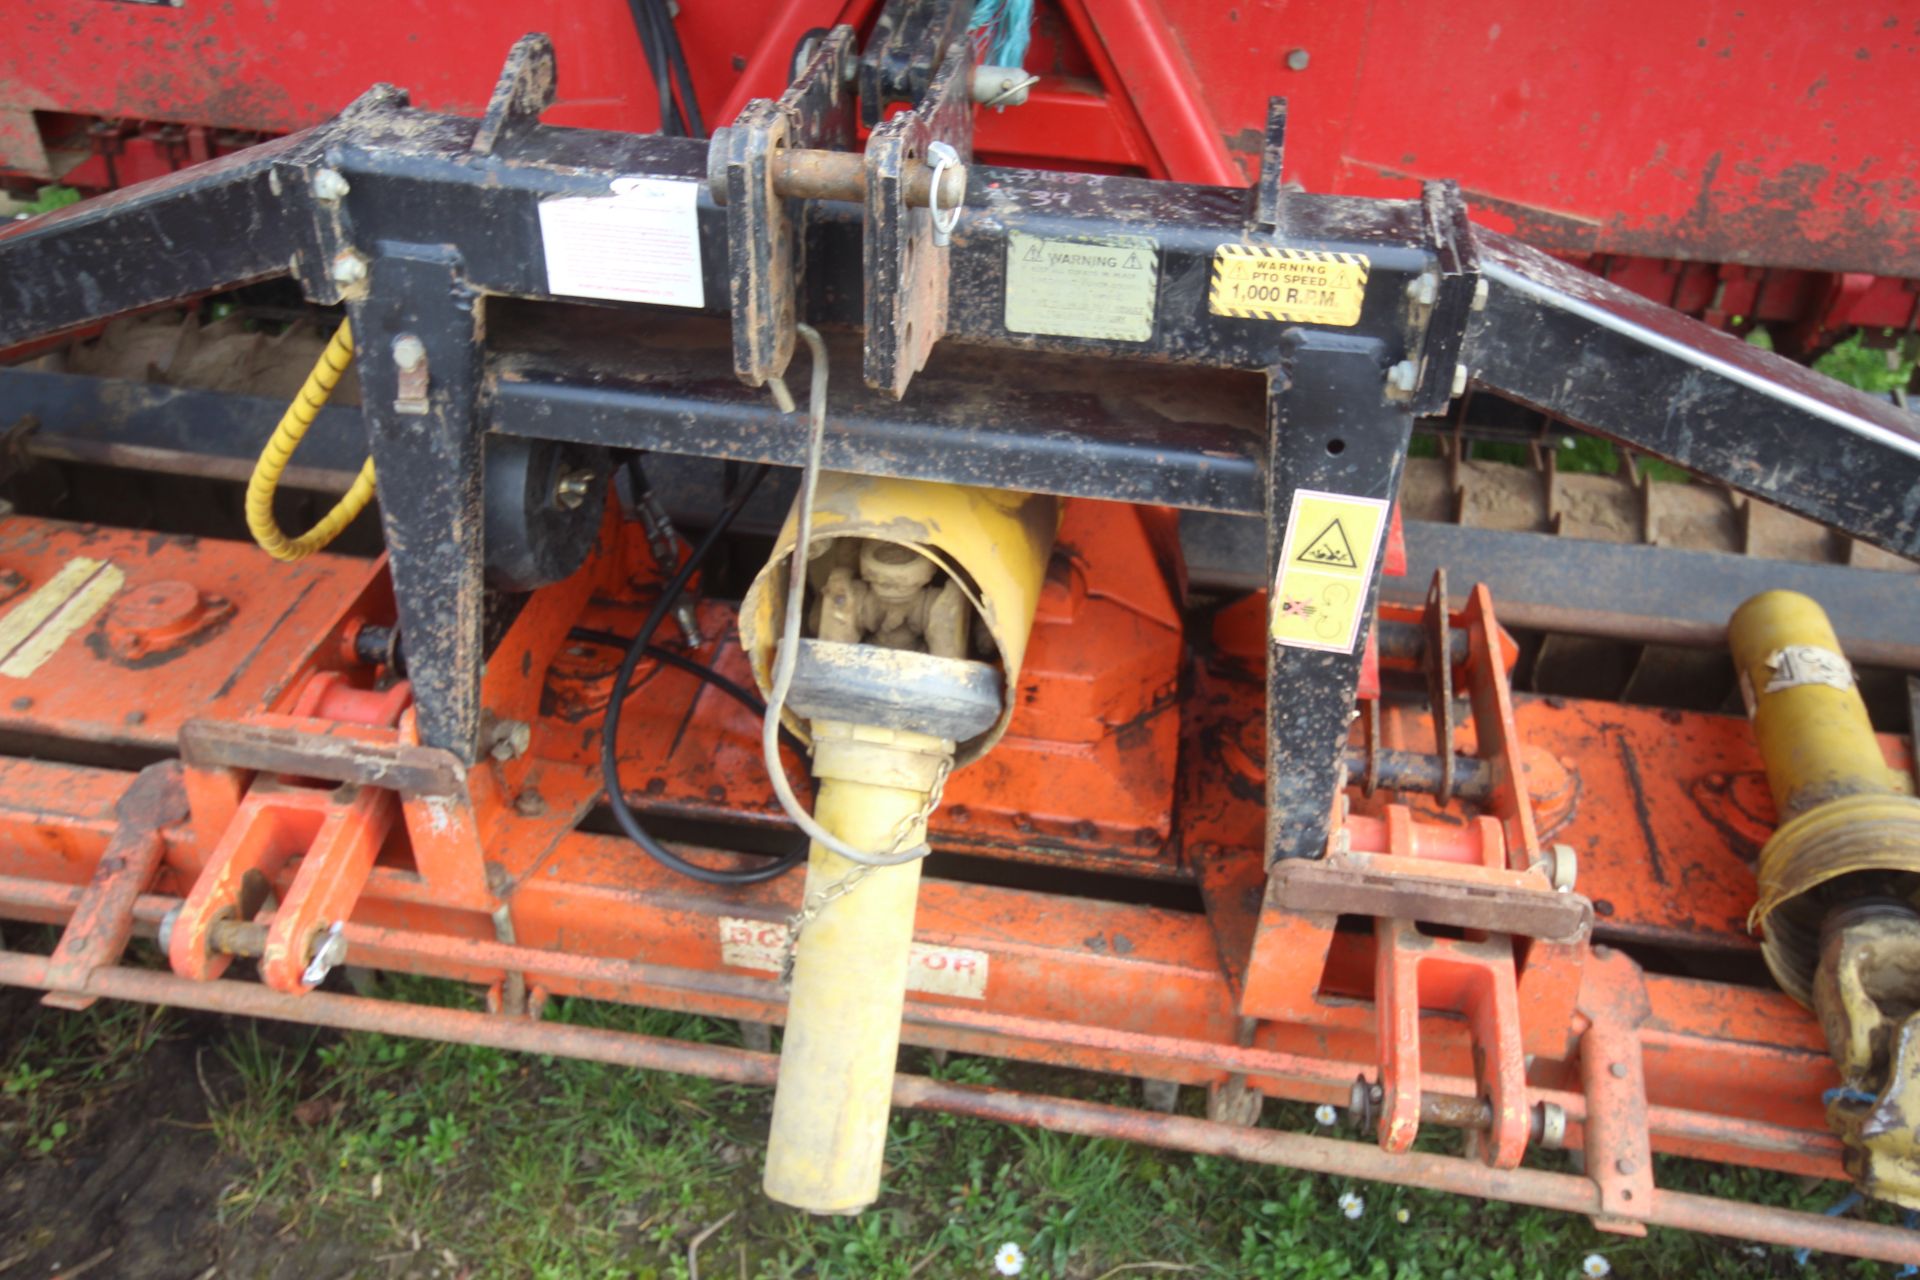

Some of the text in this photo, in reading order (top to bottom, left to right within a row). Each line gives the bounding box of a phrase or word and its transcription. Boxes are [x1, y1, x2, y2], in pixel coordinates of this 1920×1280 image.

[1048, 252, 1118, 268] WARNING
[1257, 261, 1327, 274] WARNING
[1252, 271, 1328, 287] PTO SPEED
[1232, 283, 1281, 302] 1,000
